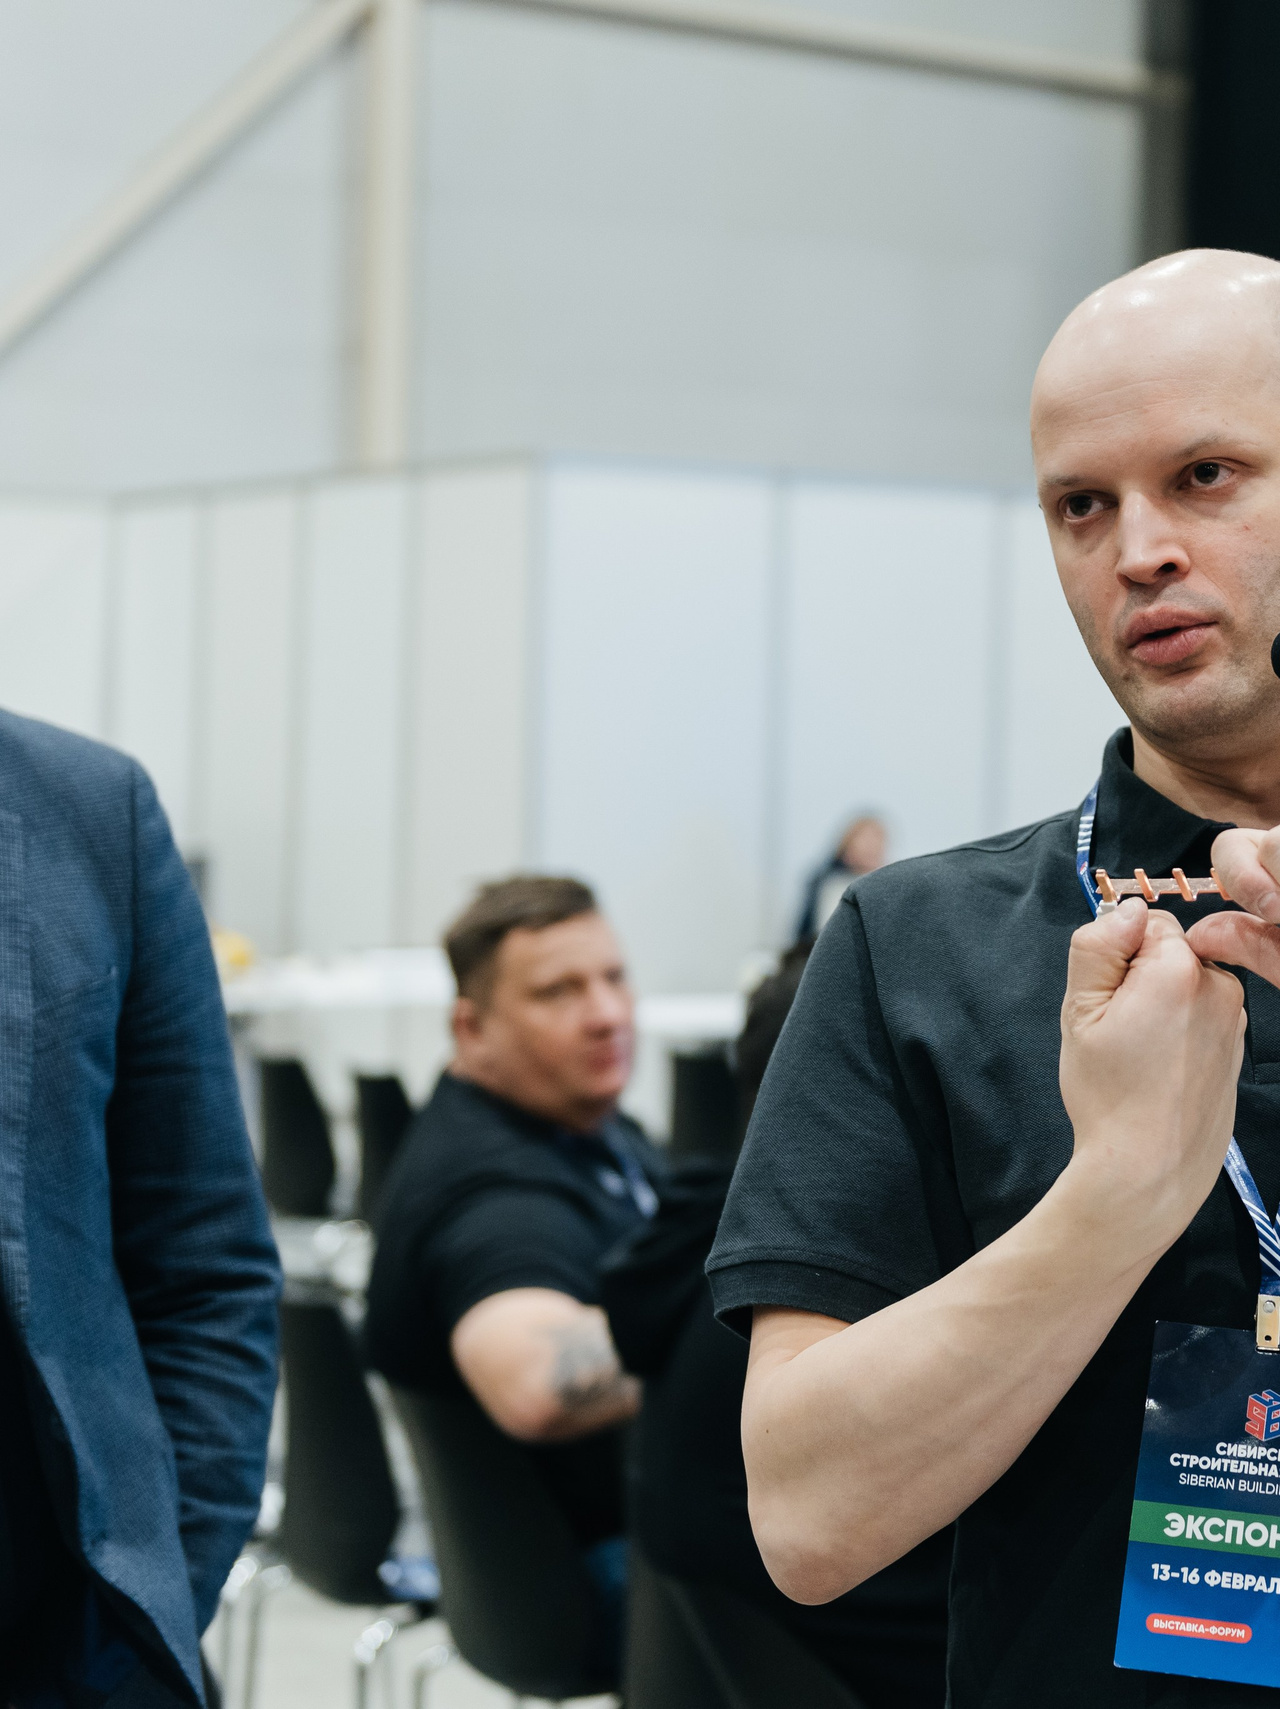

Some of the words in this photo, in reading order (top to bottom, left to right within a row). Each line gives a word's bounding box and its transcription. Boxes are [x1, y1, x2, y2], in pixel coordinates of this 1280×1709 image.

[1178, 1473, 1235, 1490] SIBERIAN
[1151, 1563, 1200, 1585] 13-16
[1153, 1618, 1245, 1639] ВЫСТАВКА-ФОРУМ
